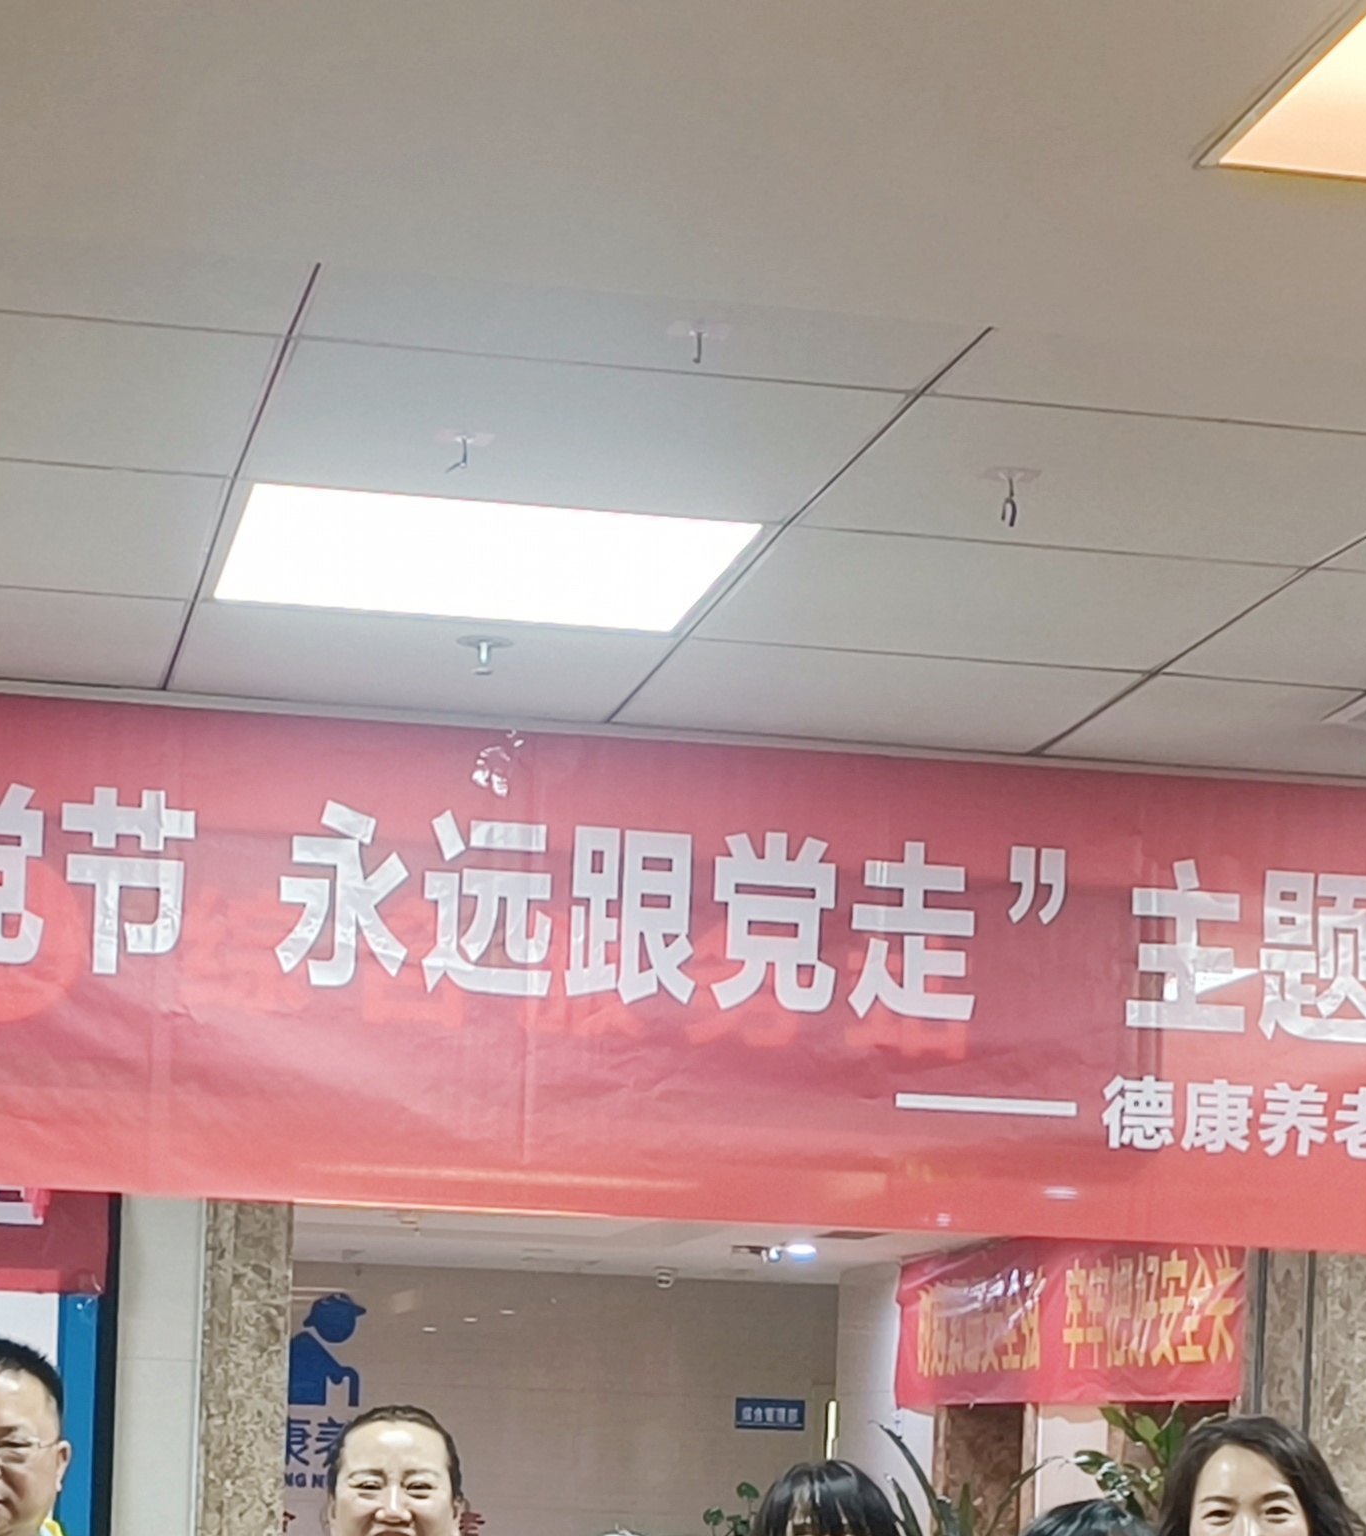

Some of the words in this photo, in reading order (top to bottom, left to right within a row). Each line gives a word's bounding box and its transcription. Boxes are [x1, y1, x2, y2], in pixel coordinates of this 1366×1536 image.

[276, 800, 1066, 1020] 永远跟党走”
